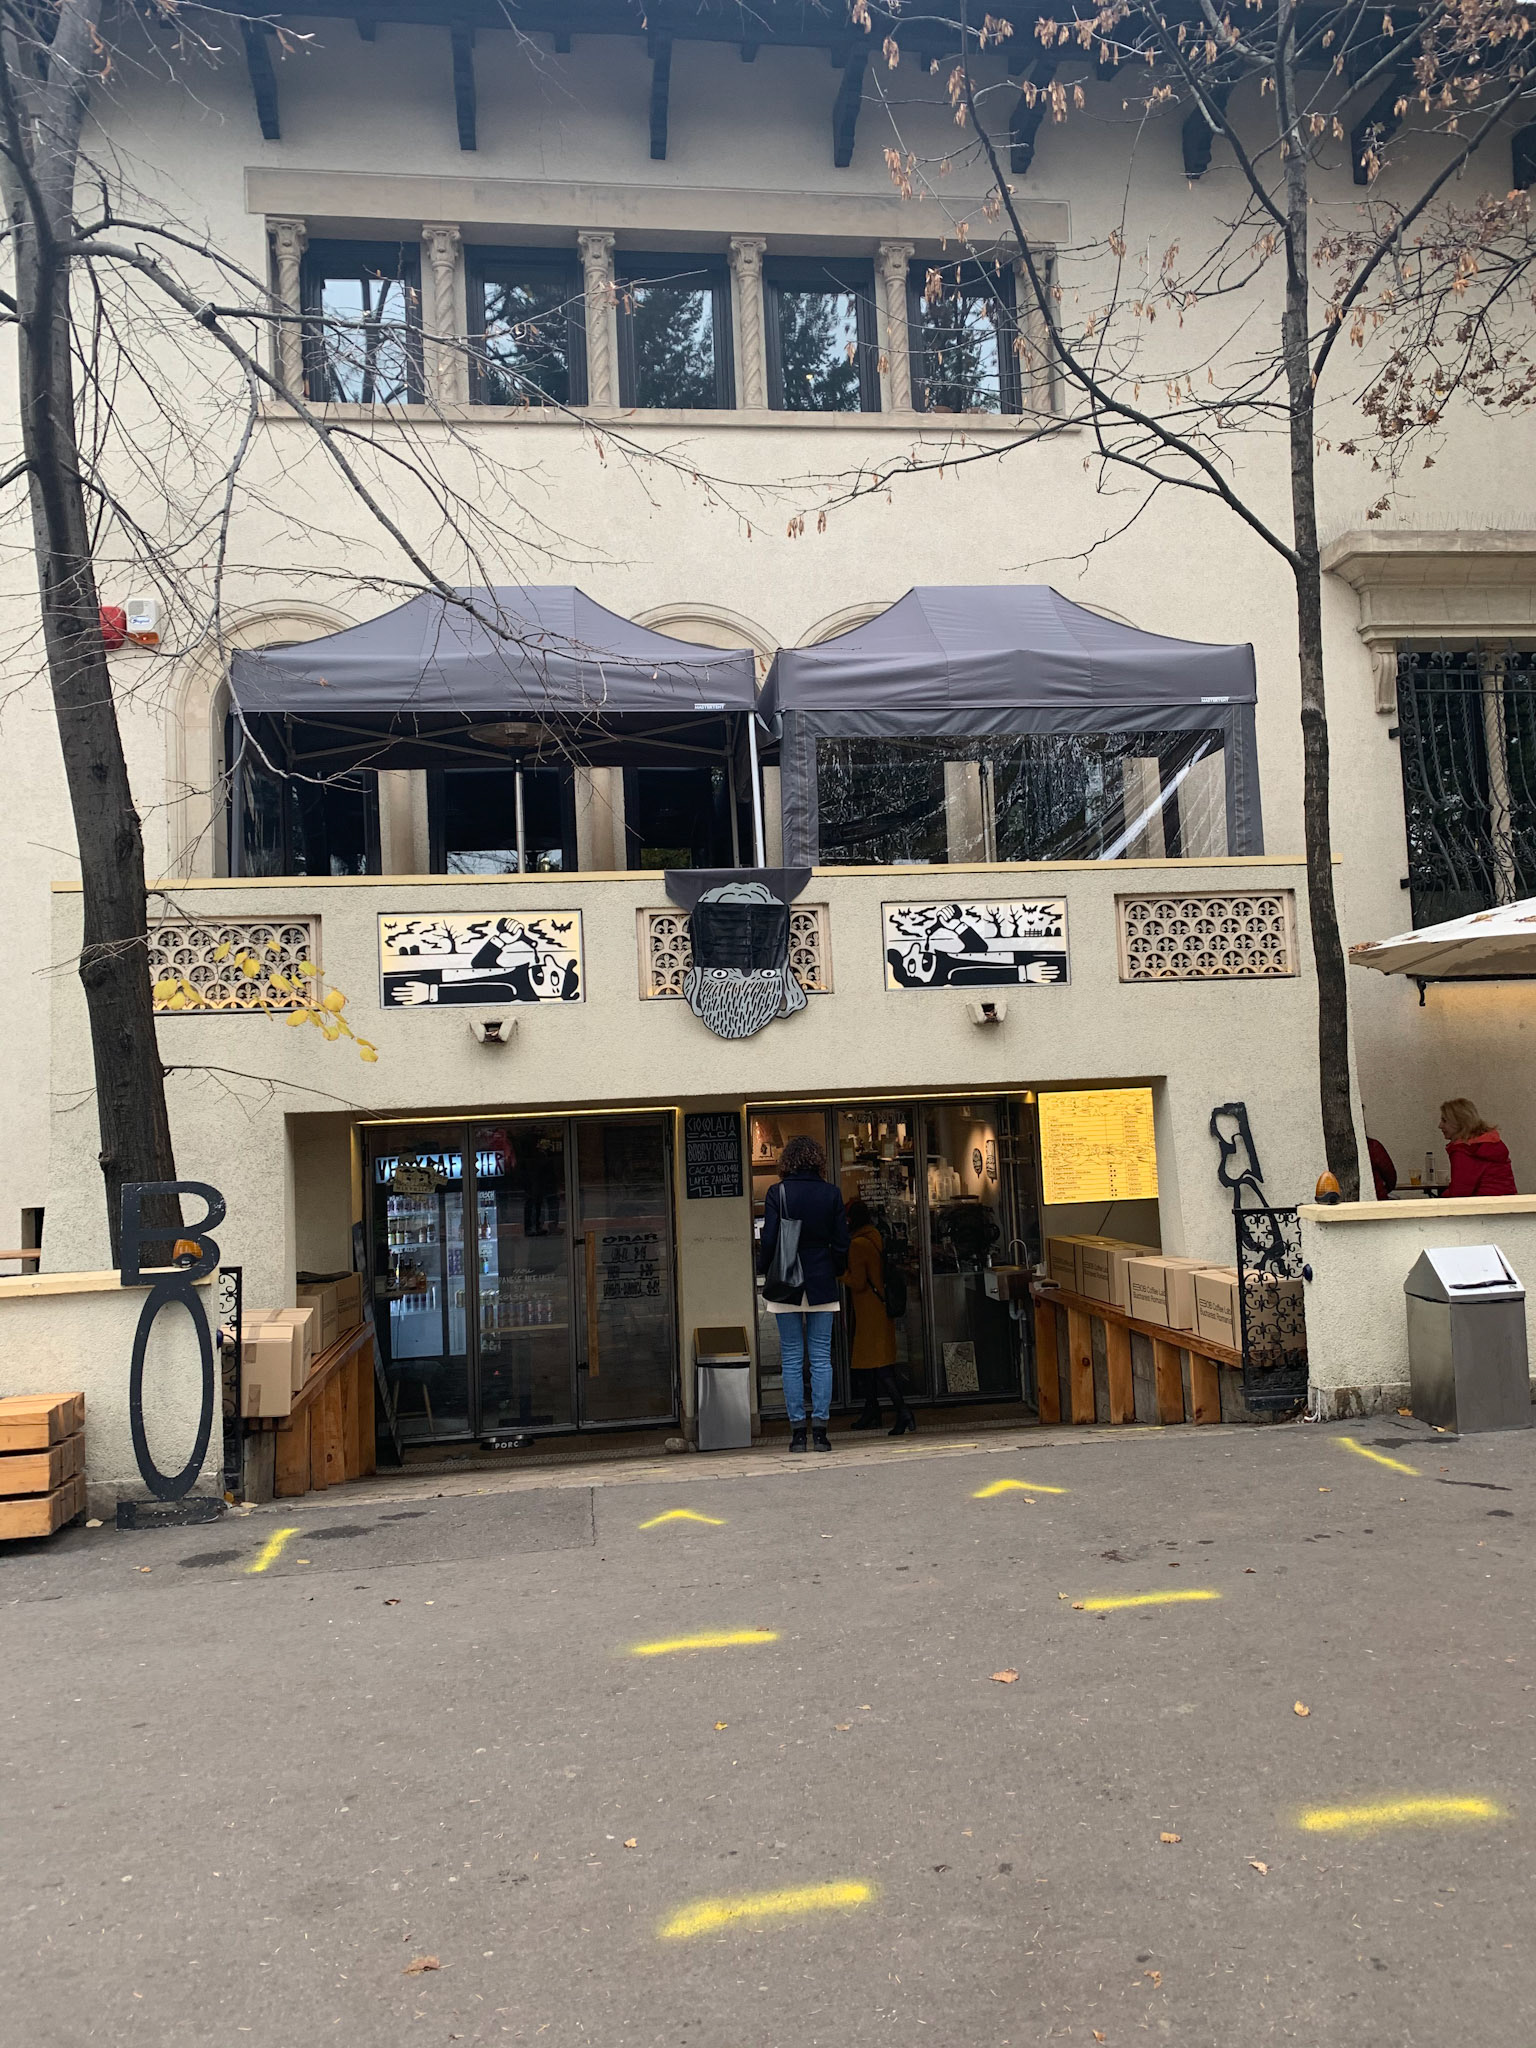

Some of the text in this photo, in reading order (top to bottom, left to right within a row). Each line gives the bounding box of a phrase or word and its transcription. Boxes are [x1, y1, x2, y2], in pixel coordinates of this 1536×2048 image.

[687, 1143, 712, 1161] BOBBY
[688, 1165, 715, 1175] CACAO
[602, 1233, 658, 1244] ORAR
